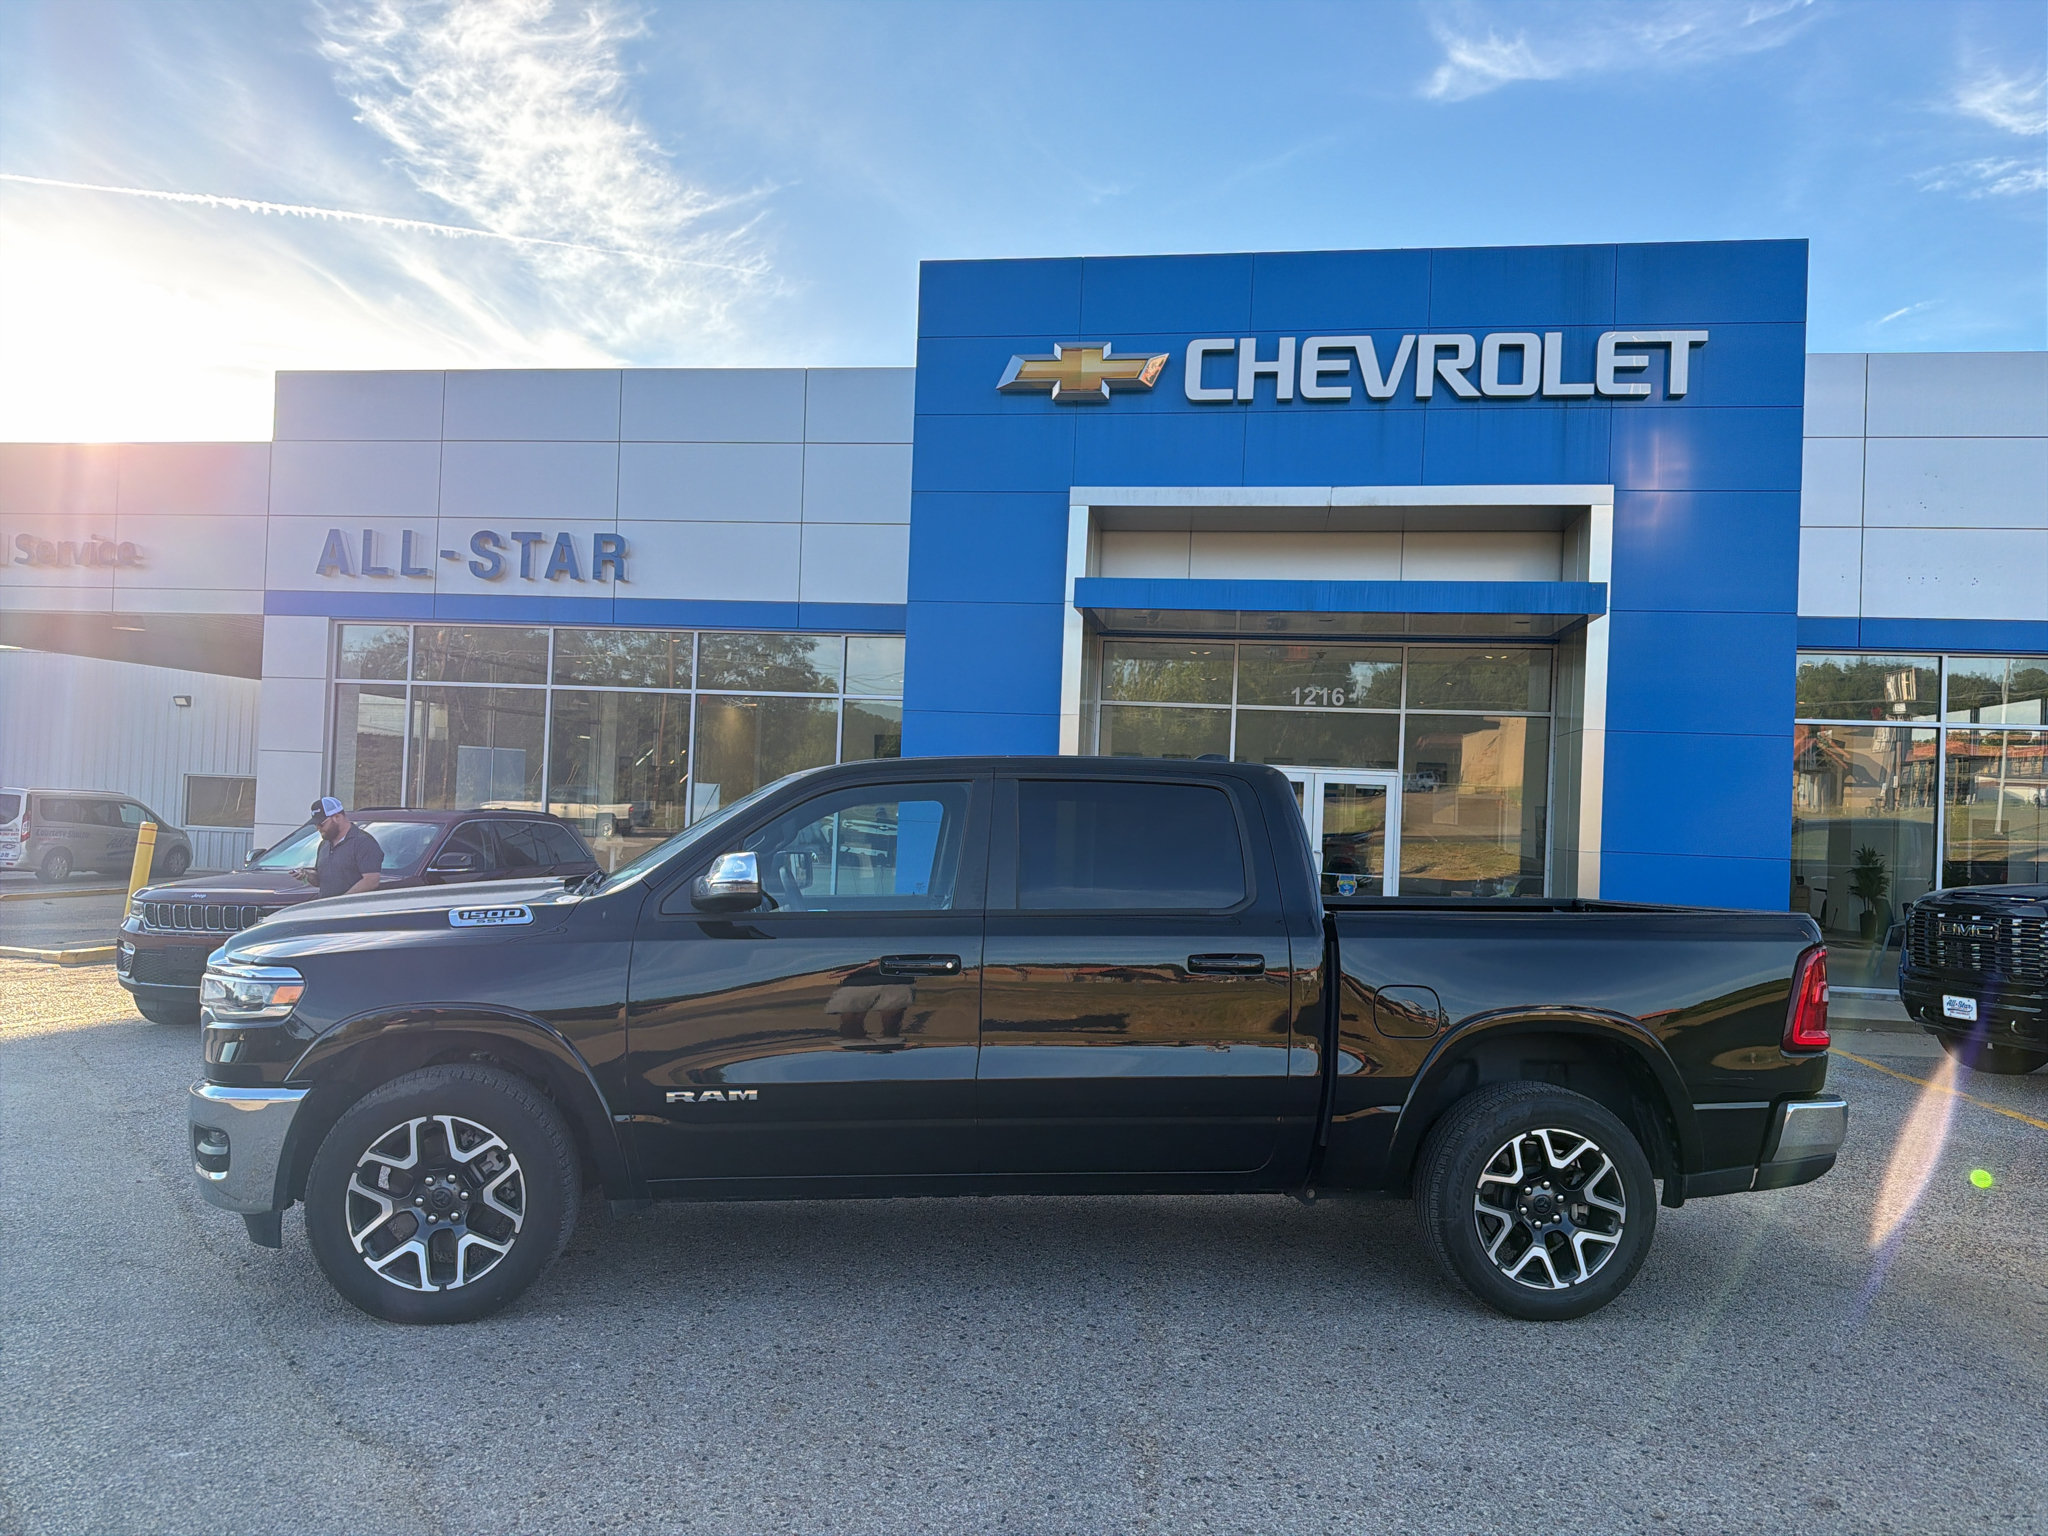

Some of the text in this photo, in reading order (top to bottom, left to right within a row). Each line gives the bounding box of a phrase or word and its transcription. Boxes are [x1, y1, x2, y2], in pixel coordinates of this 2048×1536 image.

[1184, 329, 1709, 401] CHEVROLET
[13, 533, 145, 567] Service
[315, 528, 632, 584] ALL-STAR
[1291, 686, 1345, 706] 1216
[461, 909, 521, 919] 1500
[1941, 922, 1993, 938] GMC
[666, 1090, 758, 1103] RAM
